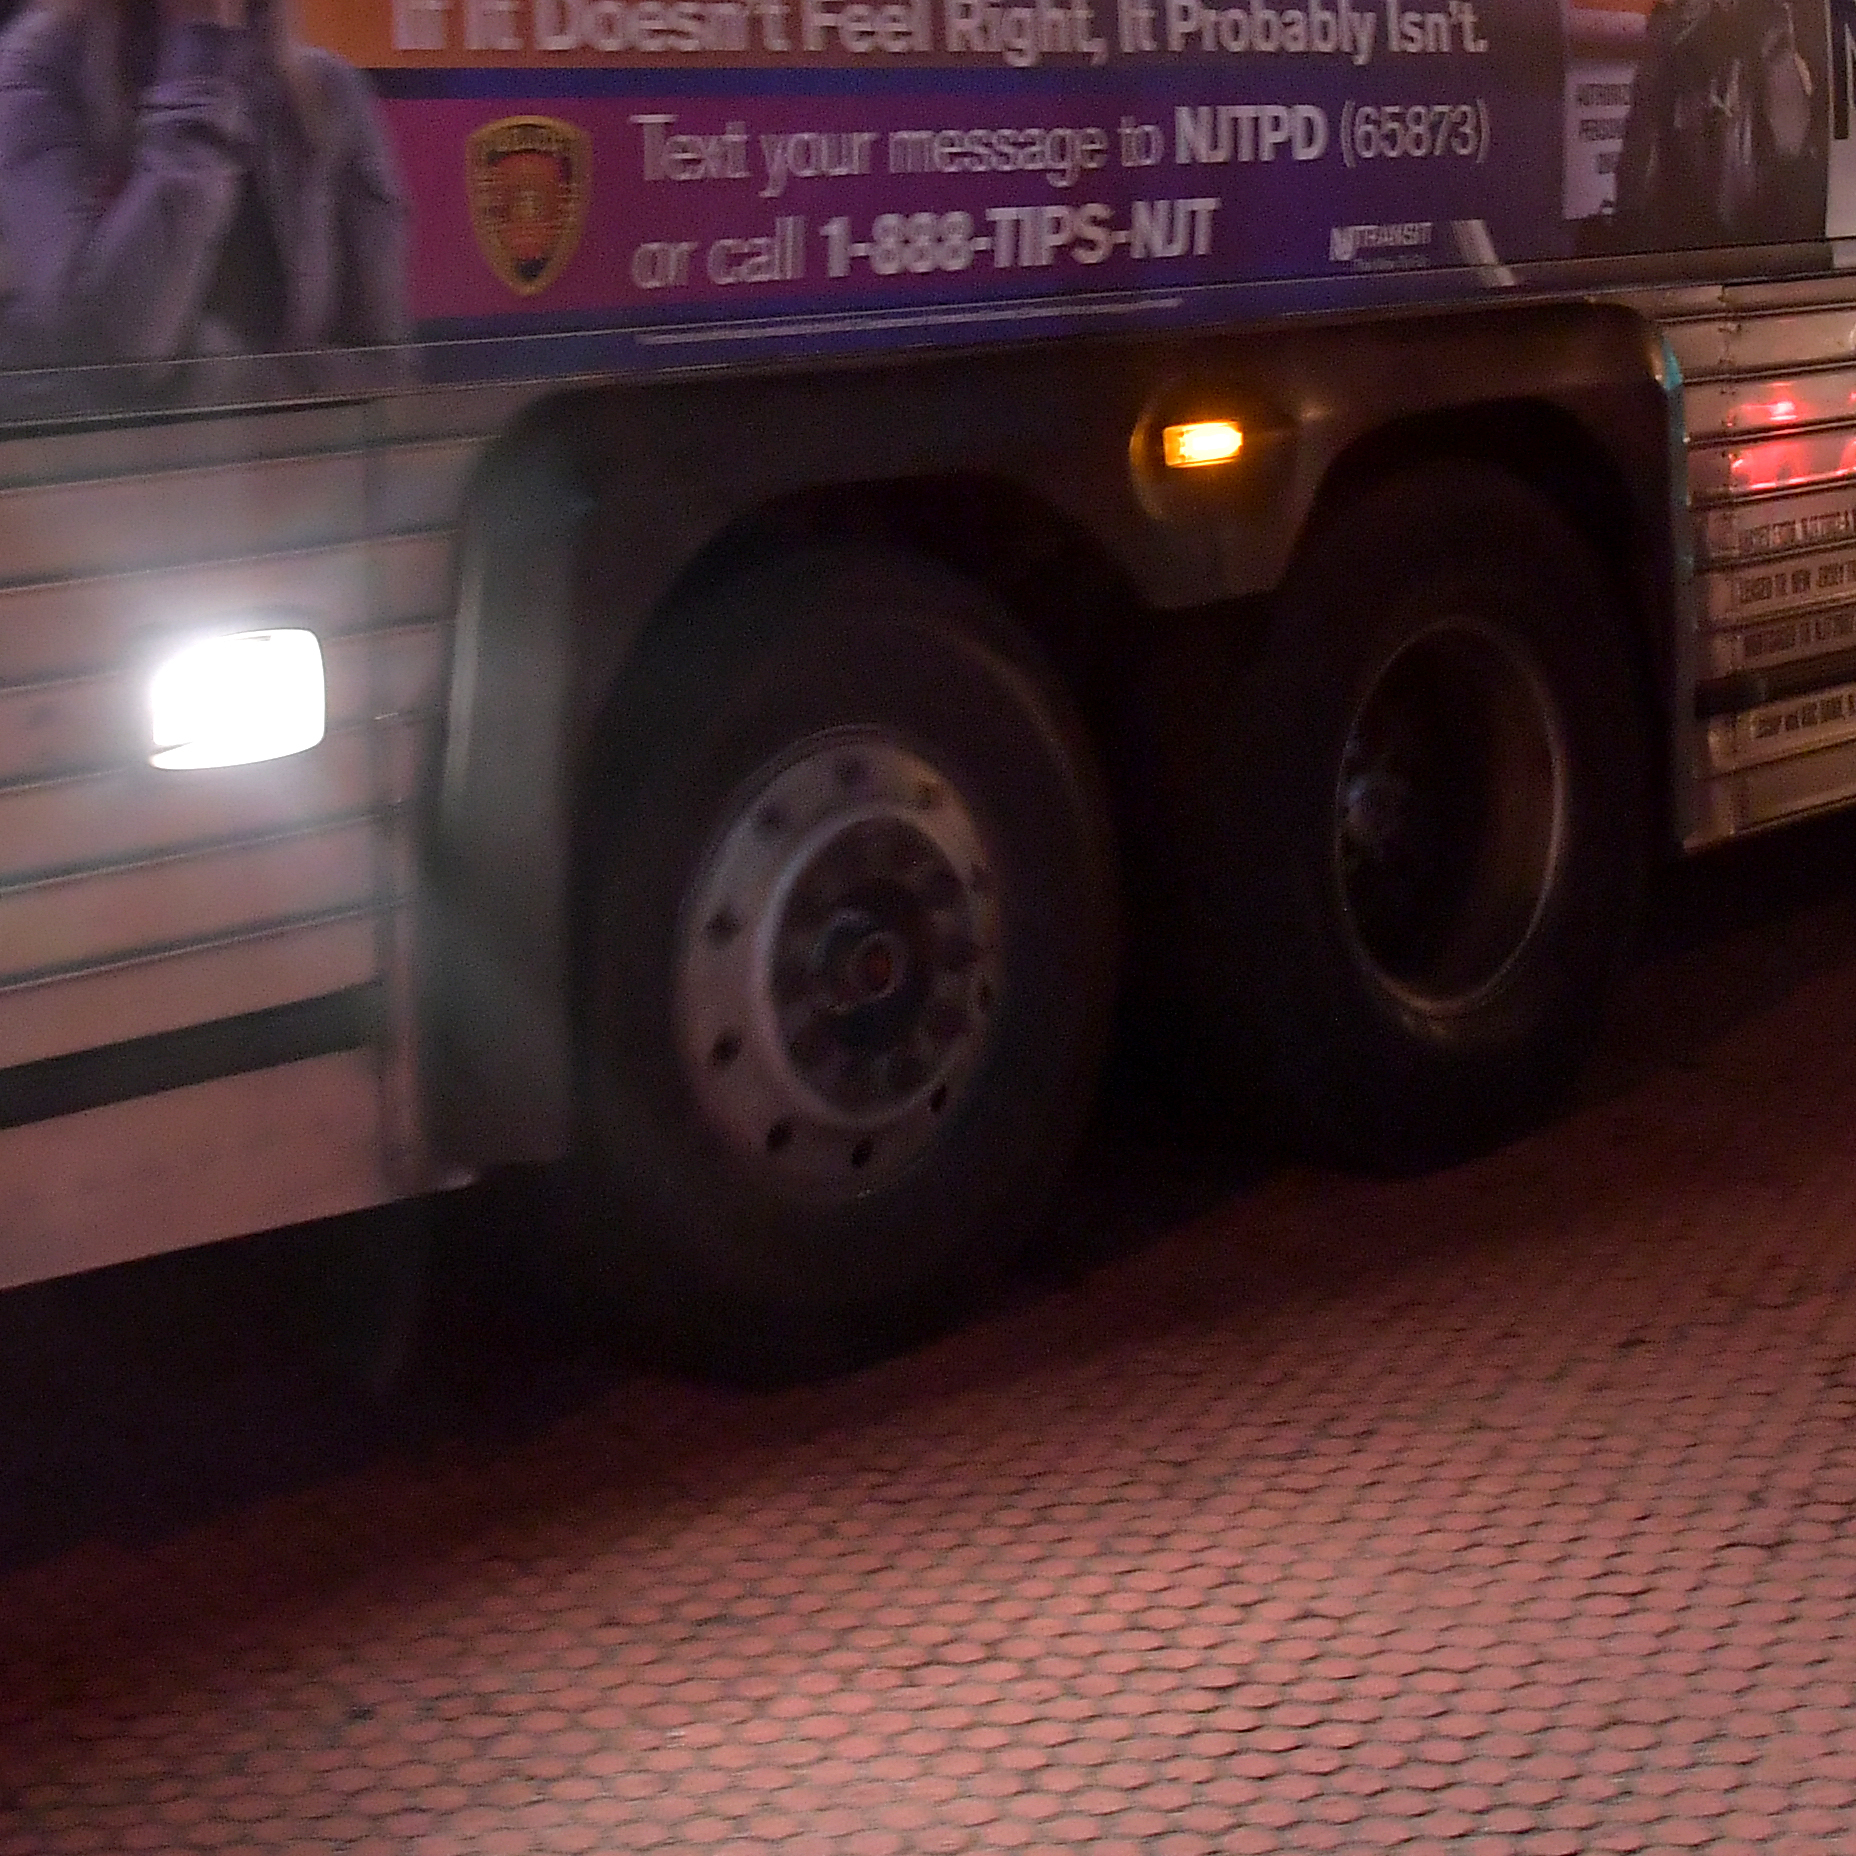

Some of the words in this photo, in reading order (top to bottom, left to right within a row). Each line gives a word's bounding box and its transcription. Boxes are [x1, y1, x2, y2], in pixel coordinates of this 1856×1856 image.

[628, 113, 751, 182] Text
[758, 131, 880, 199] your
[888, 126, 1110, 188] message
[1117, 115, 1165, 167] to
[1173, 104, 1330, 164] NJTPD
[1340, 99, 1491, 169] (65873)
[631, 241, 698, 290] or
[706, 214, 808, 286] call
[819, 196, 1222, 280] 1-888-TIPS-NJT
